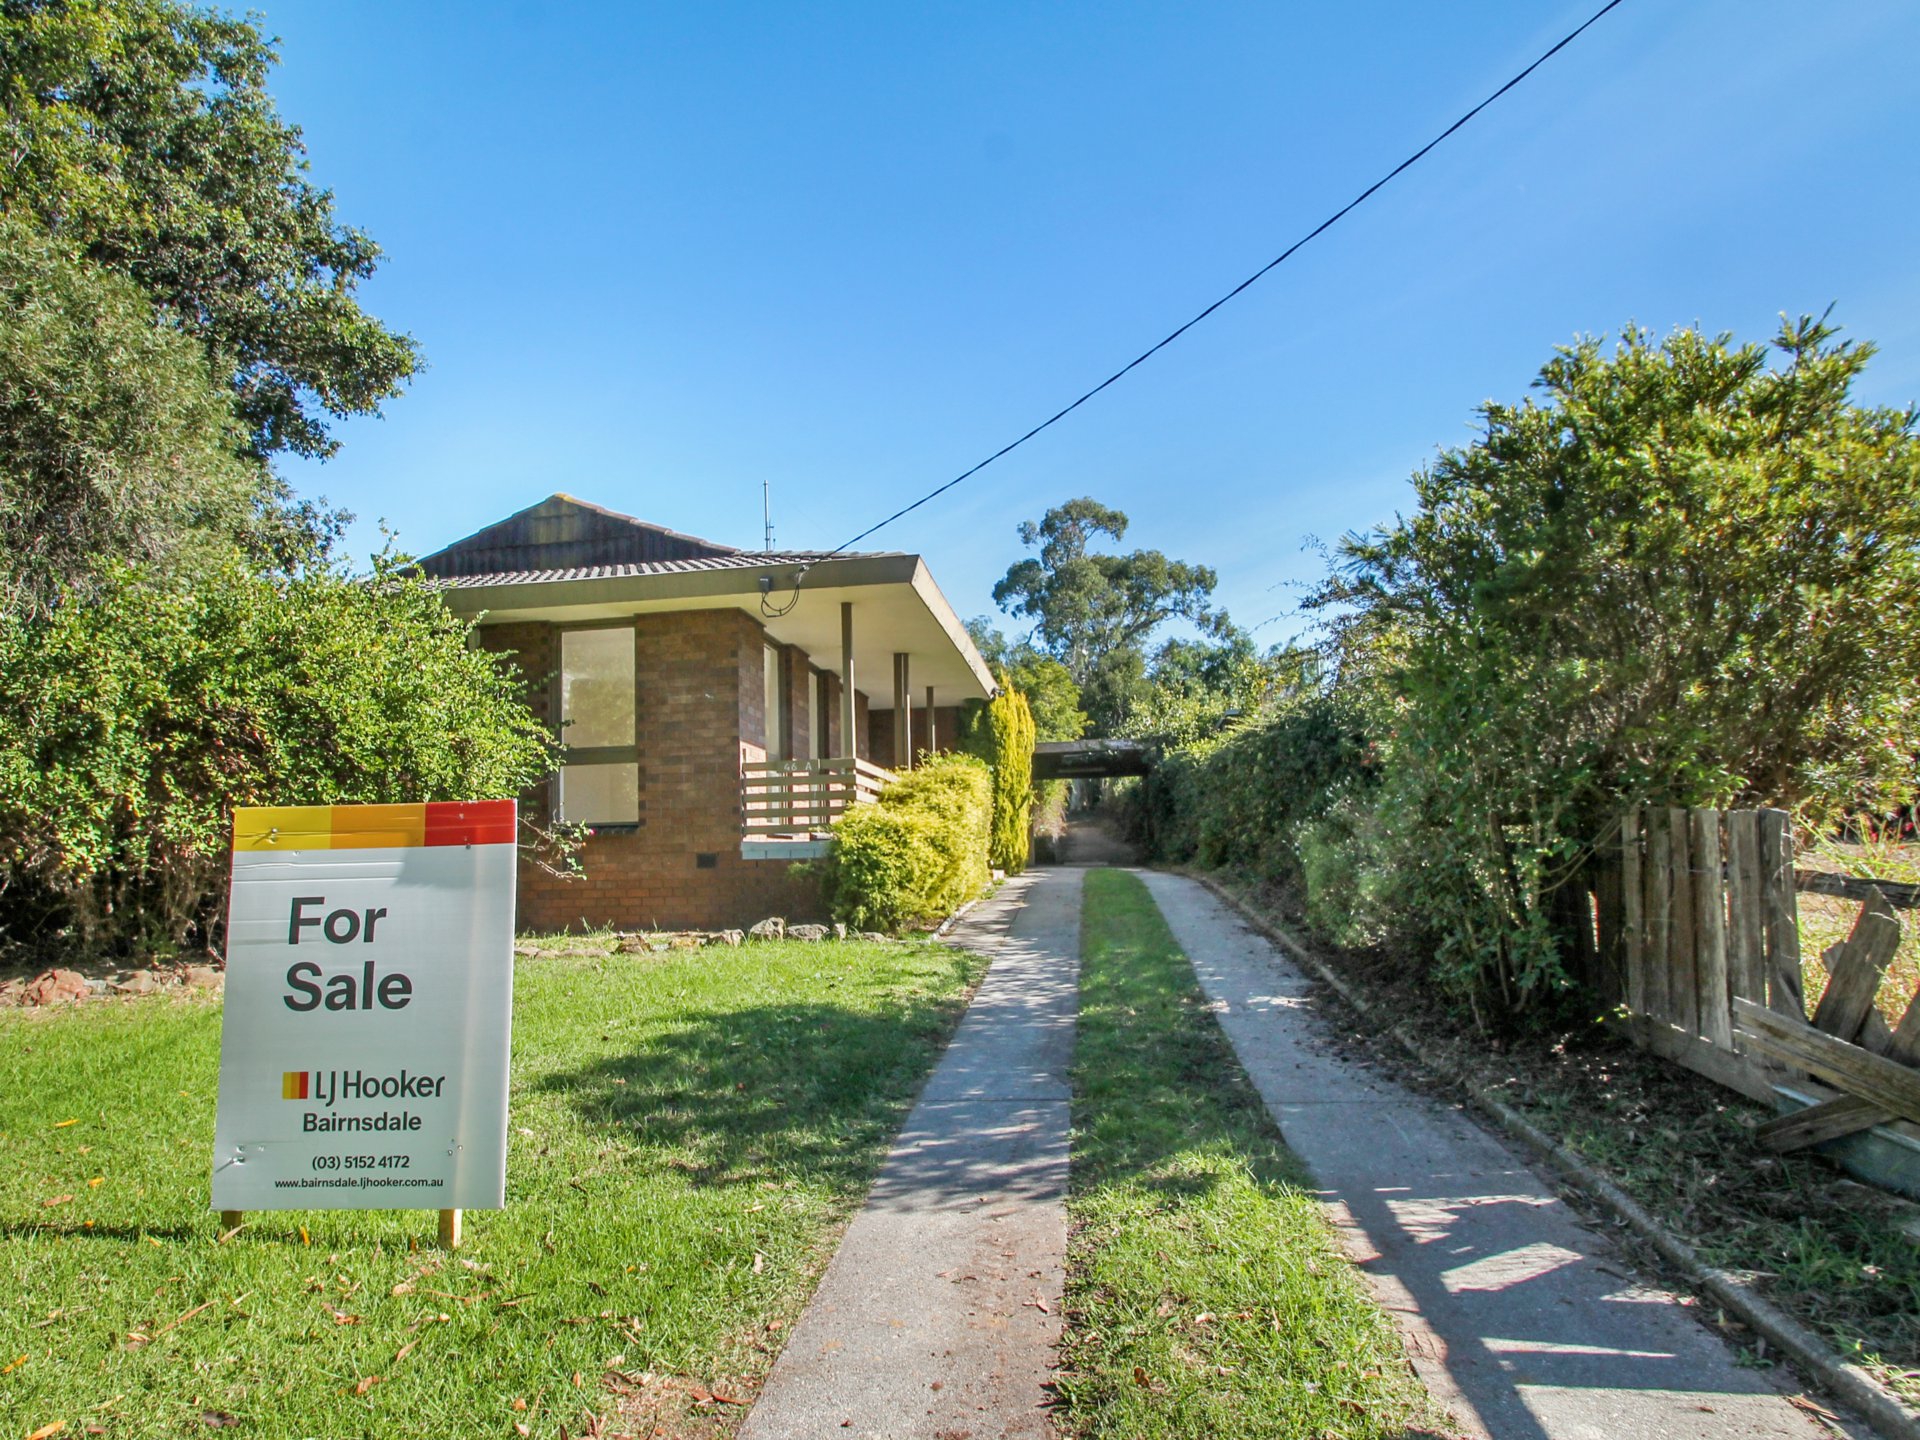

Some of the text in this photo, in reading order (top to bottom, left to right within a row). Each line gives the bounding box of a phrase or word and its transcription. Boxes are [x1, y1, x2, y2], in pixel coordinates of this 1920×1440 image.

[288, 896, 388, 945] For
[283, 960, 413, 1012] Sale
[315, 1069, 446, 1107] LJ Hooker
[302, 1111, 422, 1133] Bairnsdale
[311, 1155, 410, 1171] (03) 5152 4172
[274, 1176, 444, 1190] www.bairnsdale.ljhooker.com.au
